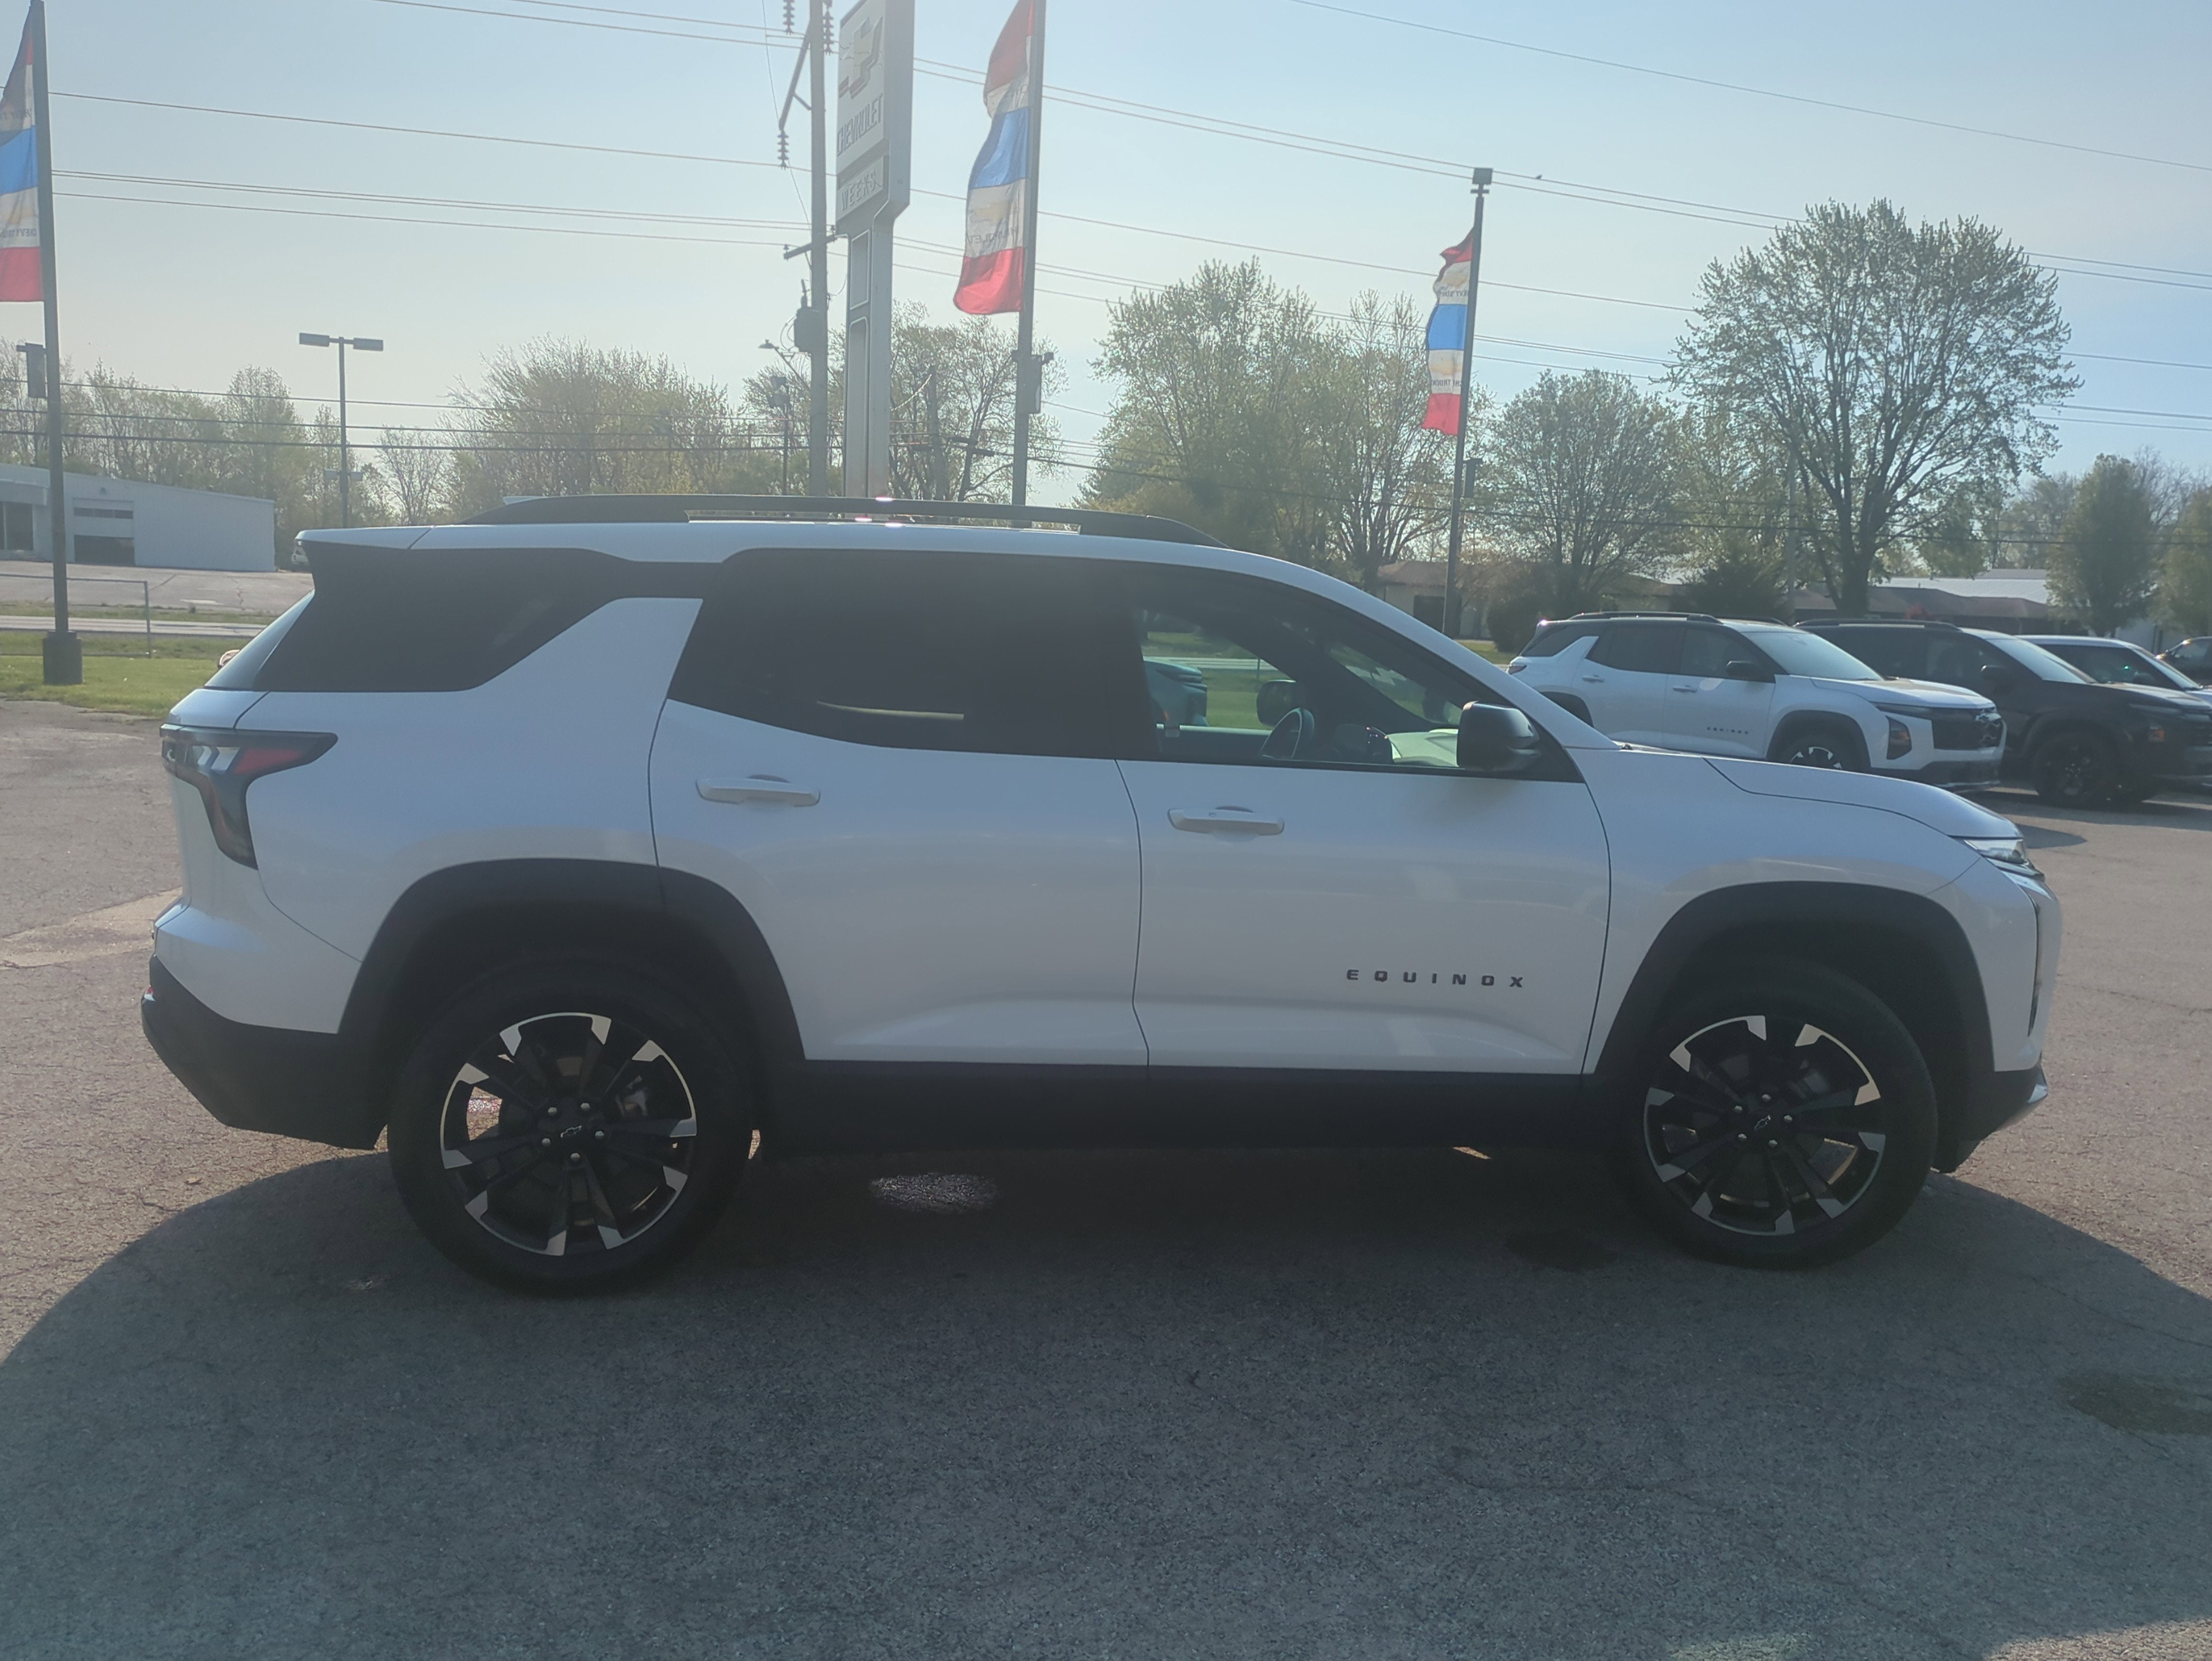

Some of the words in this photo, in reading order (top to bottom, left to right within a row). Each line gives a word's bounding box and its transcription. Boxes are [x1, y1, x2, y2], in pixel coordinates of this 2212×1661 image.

[837, 92, 883, 158] CHEVROLET
[841, 169, 876, 211] WEEKS
[1346, 969, 1523, 988] EQUINOX
